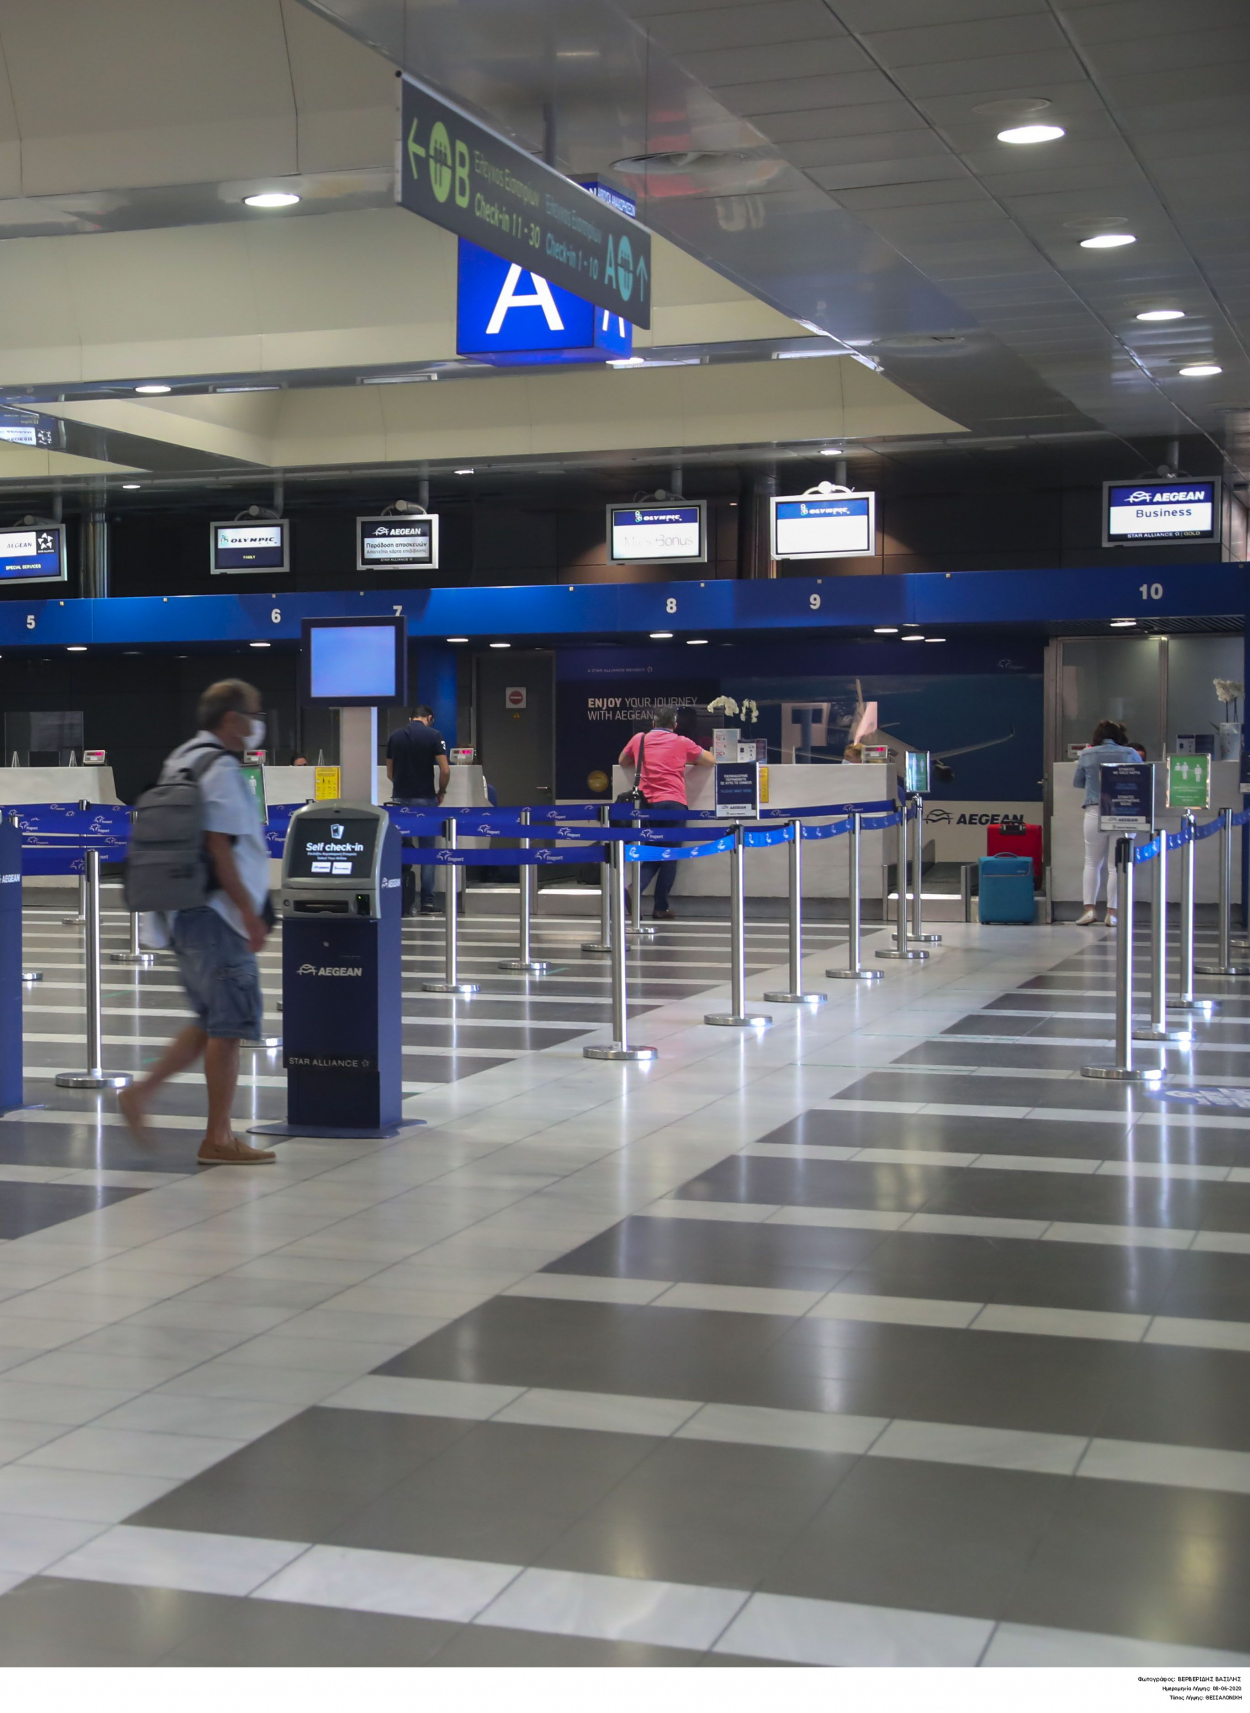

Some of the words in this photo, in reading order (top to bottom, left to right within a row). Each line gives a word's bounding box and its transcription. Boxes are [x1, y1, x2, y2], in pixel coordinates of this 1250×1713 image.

[455, 139, 469, 208] B
[475, 192, 510, 232] Check-in
[512, 213, 522, 239] 11
[528, 223, 541, 248] 30
[604, 234, 616, 289] A
[486, 263, 565, 335] A
[1153, 491, 1205, 502] AEGEAN
[1136, 508, 1192, 518] Business
[390, 528, 421, 536] AEGEAN
[230, 536, 275, 544] OLYMPIC
[366, 541, 395, 549] Παράδοση
[1139, 583, 1163, 600] 10
[666, 598, 677, 614] 8
[809, 593, 821, 610] 9
[271, 608, 281, 623] 6
[392, 605, 403, 617] 7
[26, 614, 36, 629] 5
[588, 698, 622, 708] ENJOY
[625, 697, 651, 708] YOUR
[653, 696, 697, 708] JOURNEY
[587, 710, 613, 721] WITH
[615, 710, 654, 721] AEGEAN
[956, 813, 1024, 826] AEGEAN
[306, 842, 325, 852] Self
[325, 842, 364, 852] check-in
[1, 873, 21, 883] AEGEAN
[318, 967, 363, 977] AEGEAN
[289, 1057, 310, 1065] STAR
[312, 1059, 359, 1068] ALLIANCE
